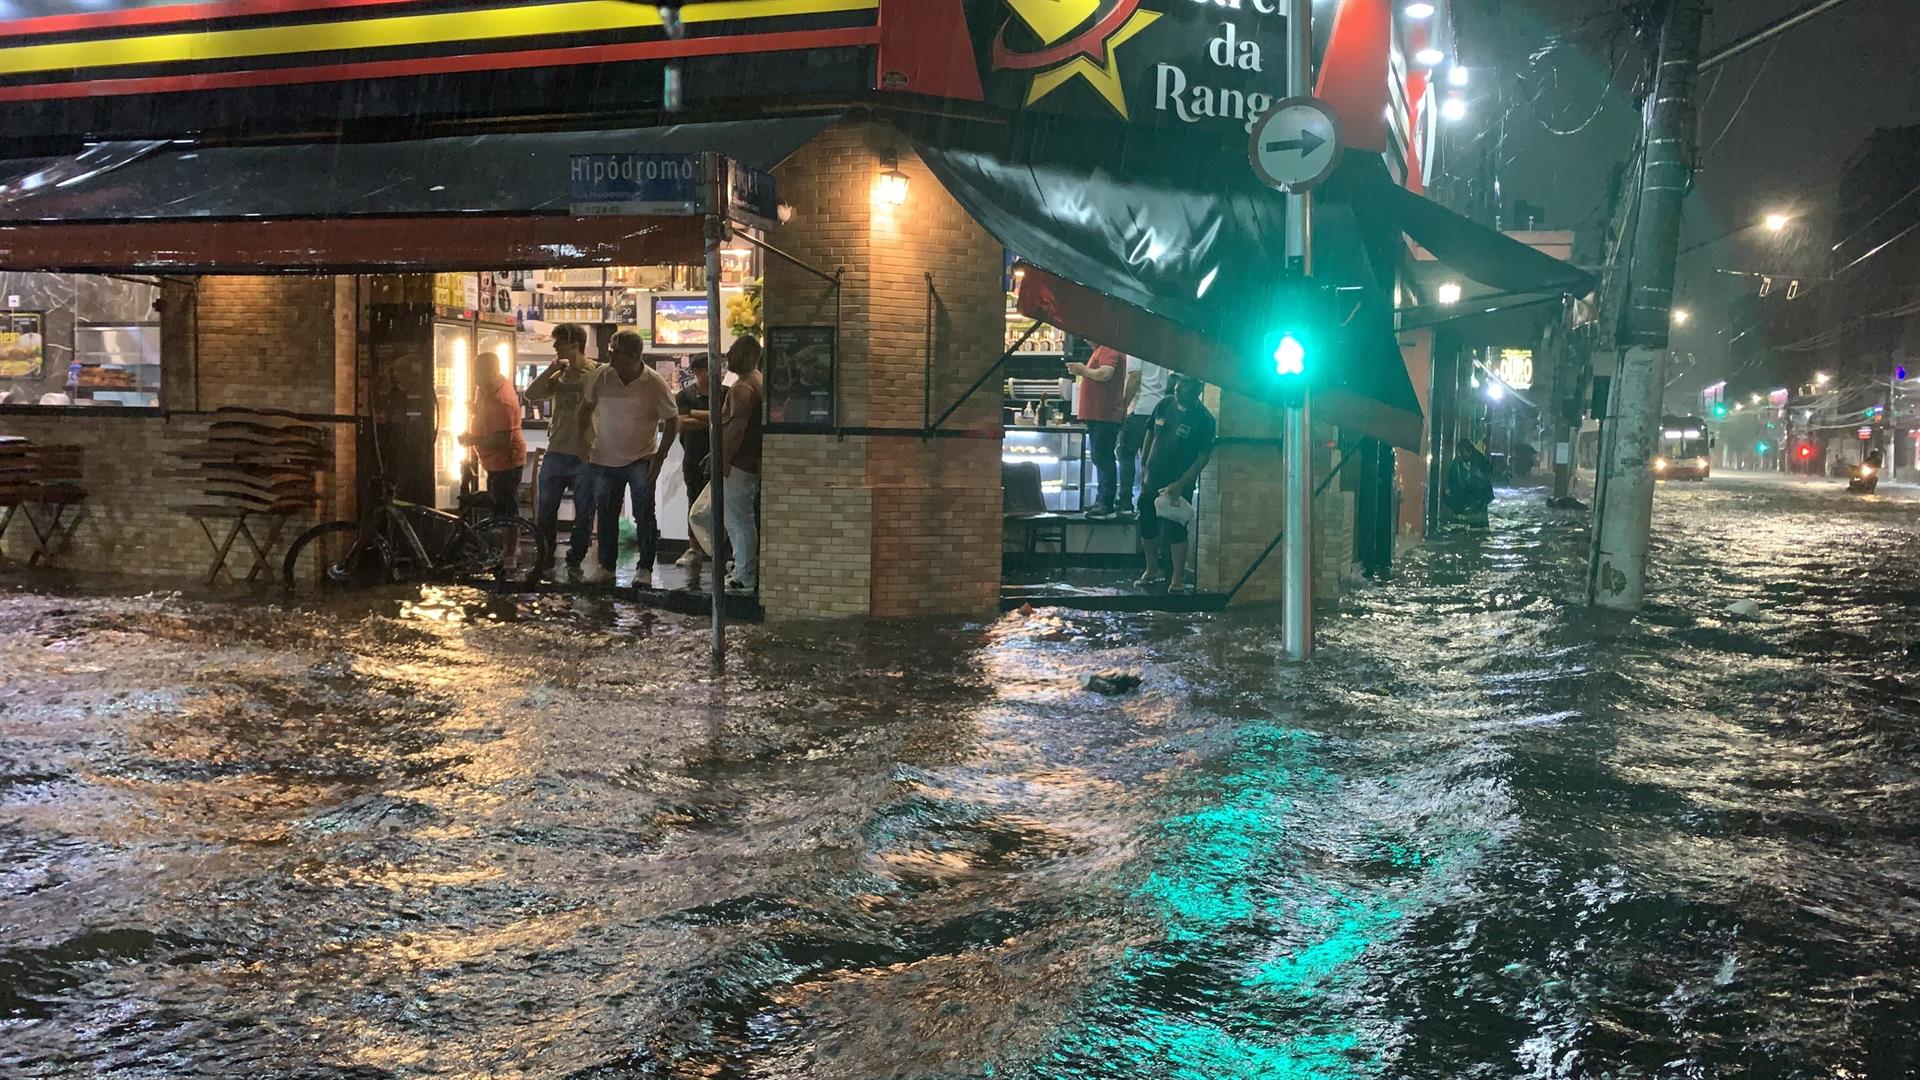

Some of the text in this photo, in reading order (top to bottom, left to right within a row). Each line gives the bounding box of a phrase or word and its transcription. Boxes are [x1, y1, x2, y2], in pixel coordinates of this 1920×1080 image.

[1209, 22, 1262, 72] da
[1155, 62, 1286, 134] Rang
[571, 155, 693, 186] Hipódromo
